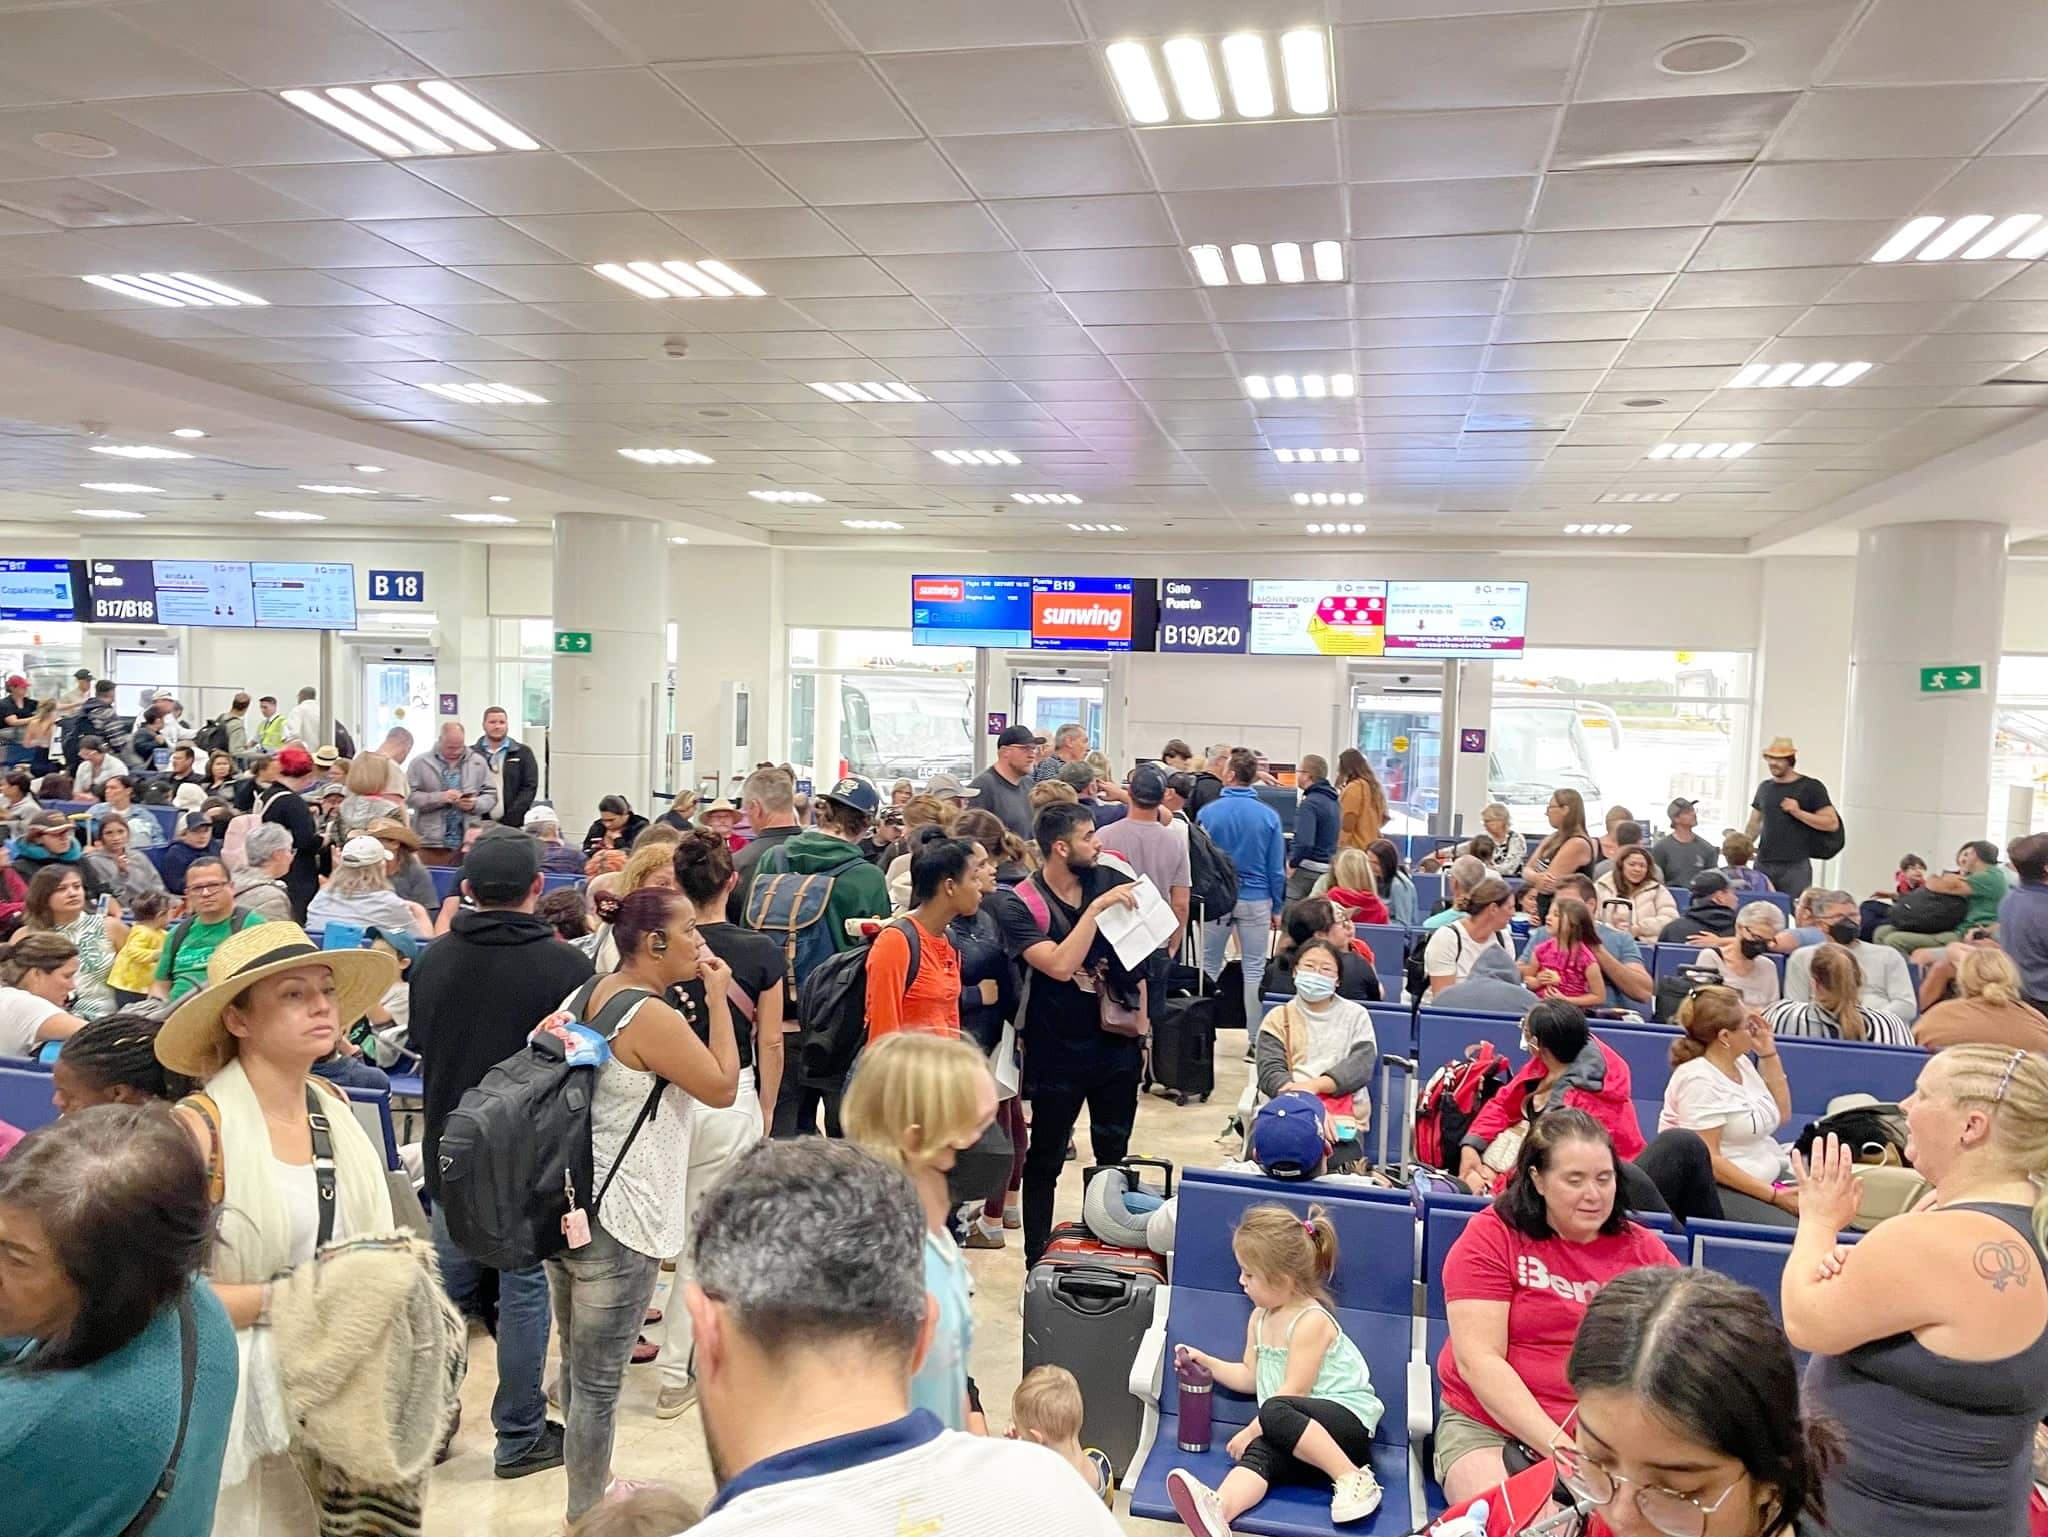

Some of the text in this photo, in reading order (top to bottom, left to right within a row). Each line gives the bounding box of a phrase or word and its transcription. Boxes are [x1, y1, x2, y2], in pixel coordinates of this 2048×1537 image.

[374, 575, 418, 597] B 18
[918, 584, 960, 598] sunwing
[1053, 581, 1076, 590] B19
[1166, 582, 1192, 595] Gate
[96, 599, 154, 619] B17/B18
[1166, 597, 1202, 610] Puerta
[1042, 602, 1122, 631] sunwing
[1164, 624, 1241, 647] B19/B20
[1518, 1255, 1606, 1304] Ben
